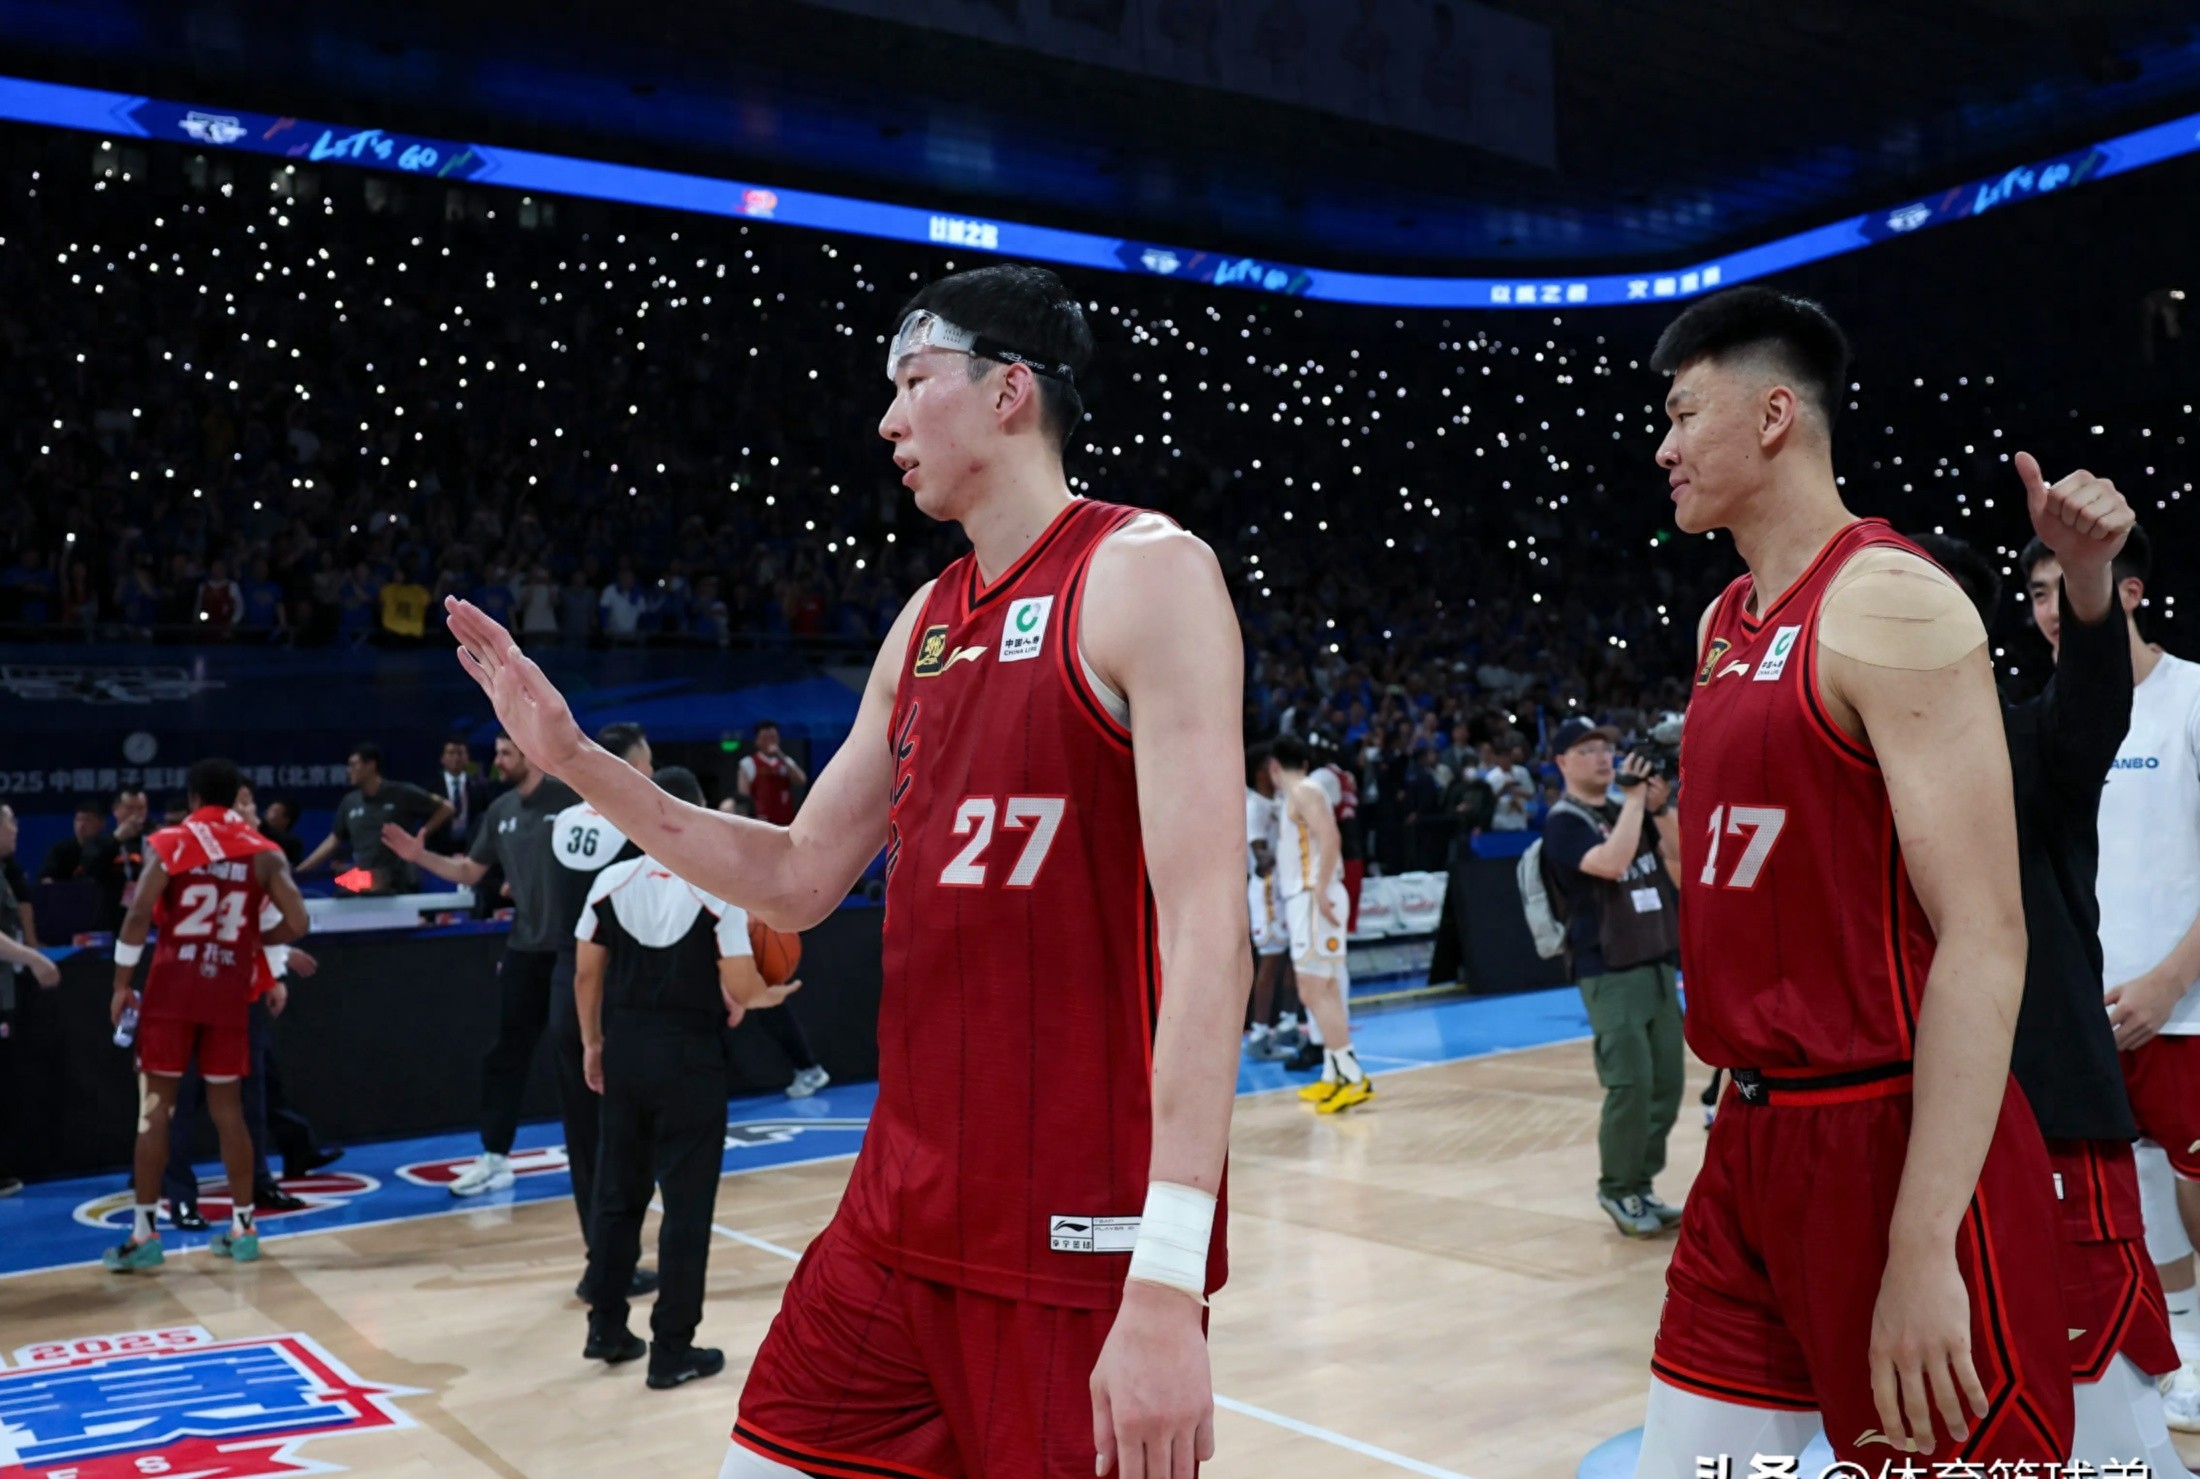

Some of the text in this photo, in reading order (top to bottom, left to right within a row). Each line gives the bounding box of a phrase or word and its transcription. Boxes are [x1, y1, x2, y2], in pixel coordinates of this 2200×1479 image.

[398, 144, 438, 171] GO
[567, 826, 599, 857] 36
[938, 797, 1067, 887] 27
[1700, 804, 1787, 889] 17
[174, 884, 248, 942] 24
[30, 1329, 198, 1361] 2025
